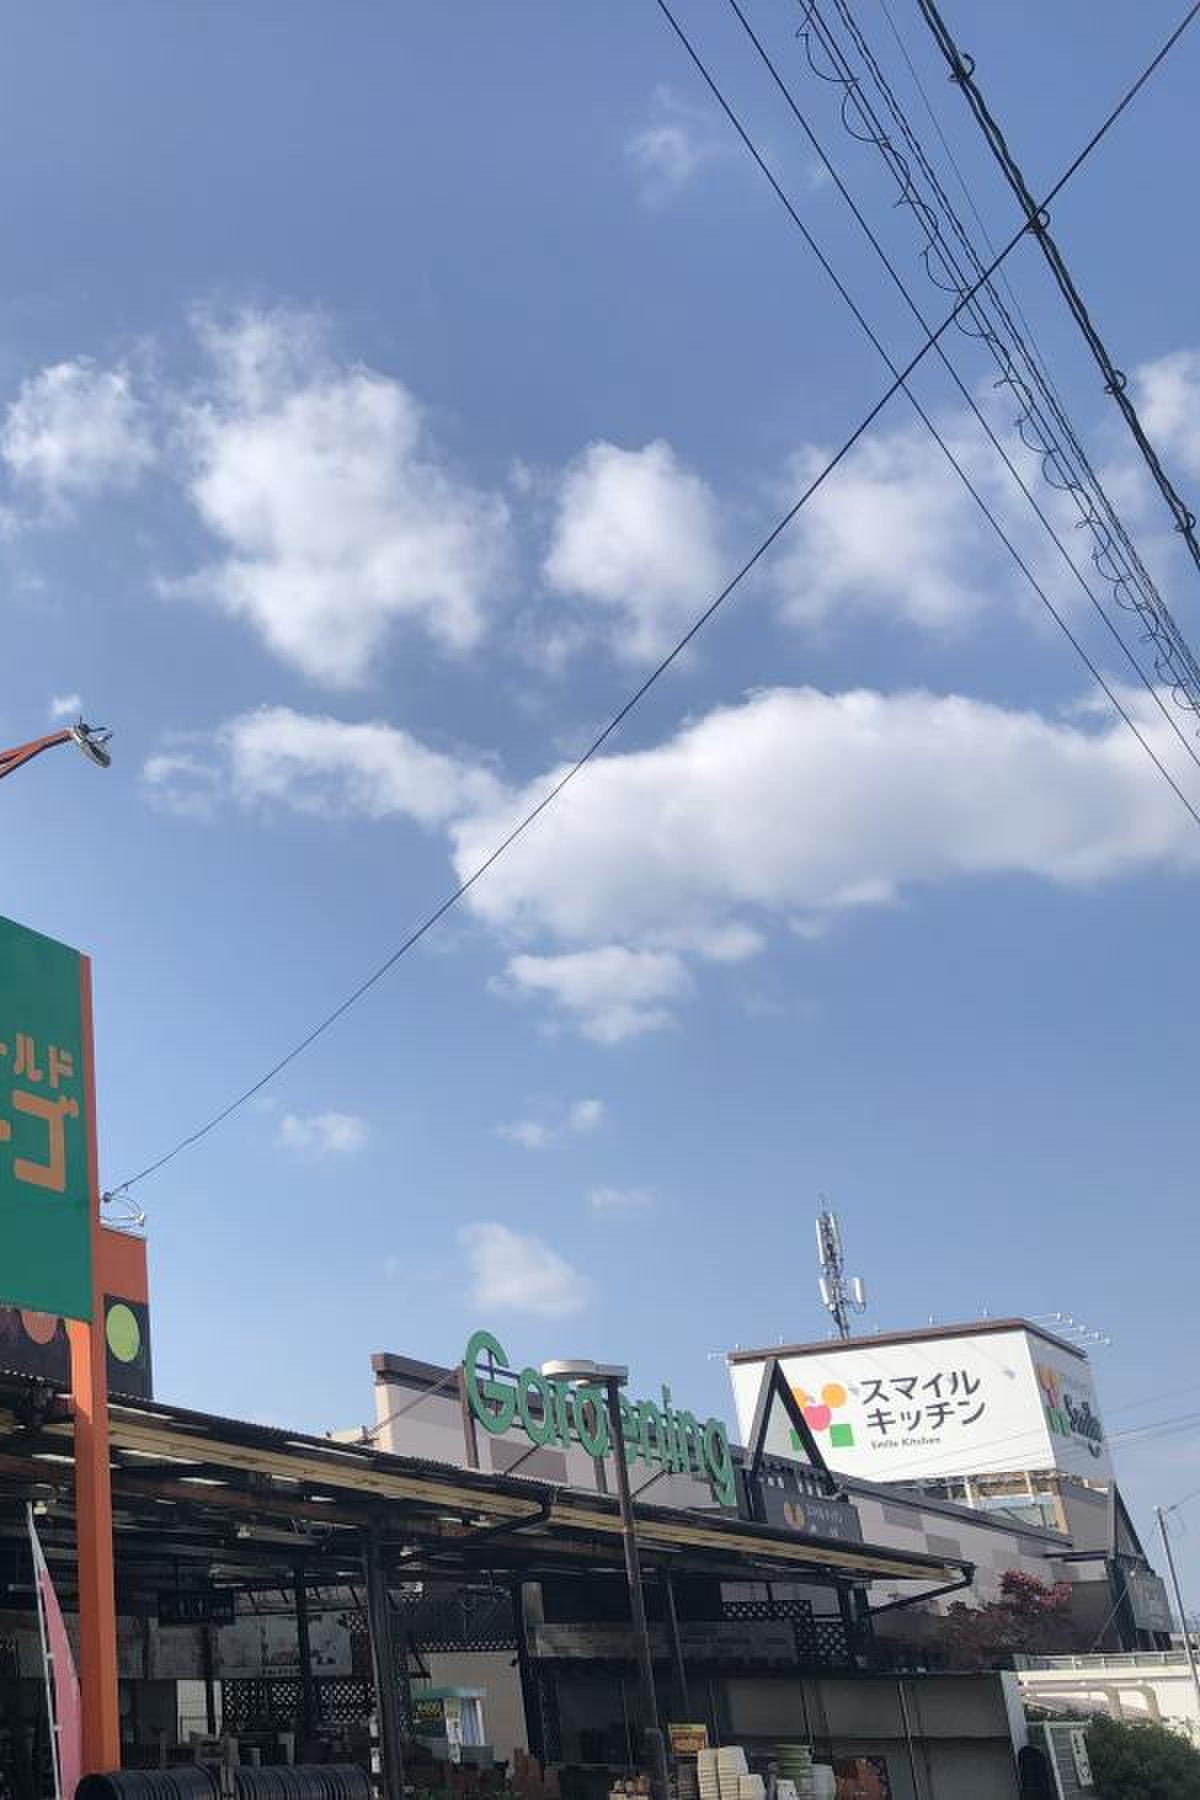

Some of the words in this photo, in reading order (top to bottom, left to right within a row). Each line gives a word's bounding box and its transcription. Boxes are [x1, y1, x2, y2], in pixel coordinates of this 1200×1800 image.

[860, 1370, 981, 1405] スマイル
[866, 1401, 985, 1435] キッチン
